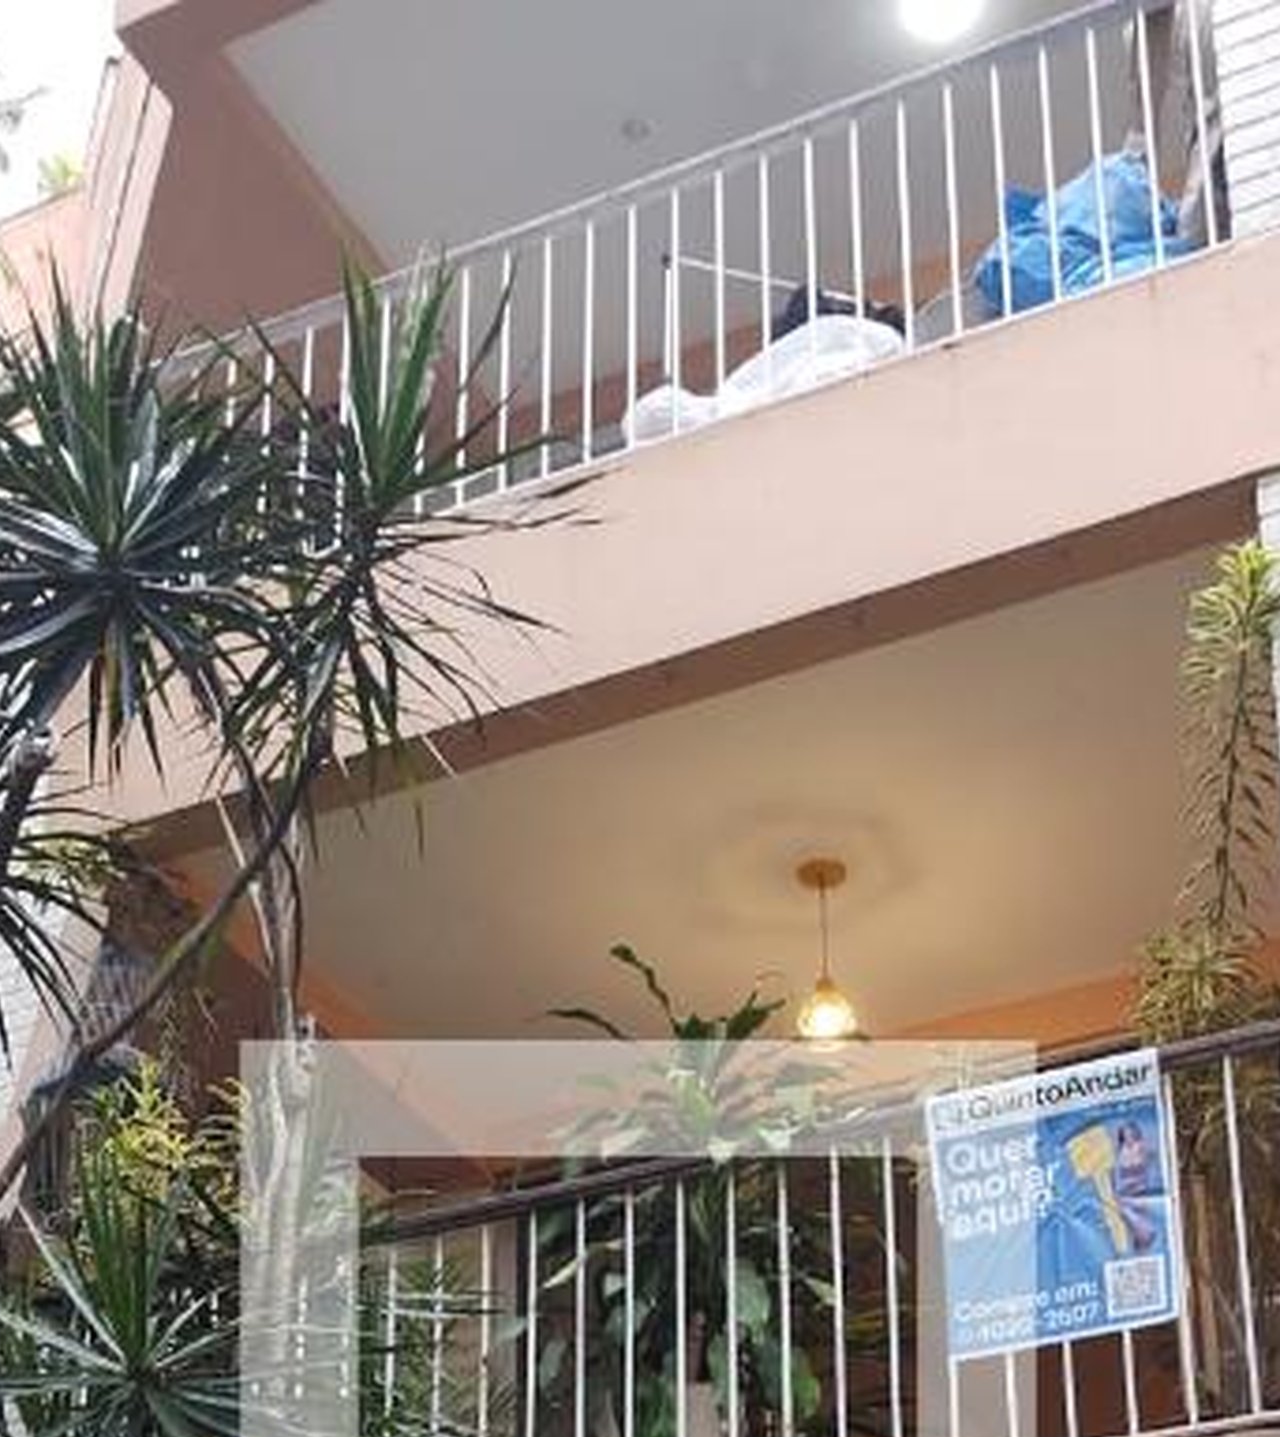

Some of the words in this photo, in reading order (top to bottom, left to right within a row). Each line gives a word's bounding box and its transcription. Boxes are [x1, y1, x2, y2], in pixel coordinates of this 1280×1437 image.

[969, 1064, 1152, 1120] QuintoAndar
[945, 1134, 1038, 1175] Quer
[951, 1163, 1061, 1206] morar
